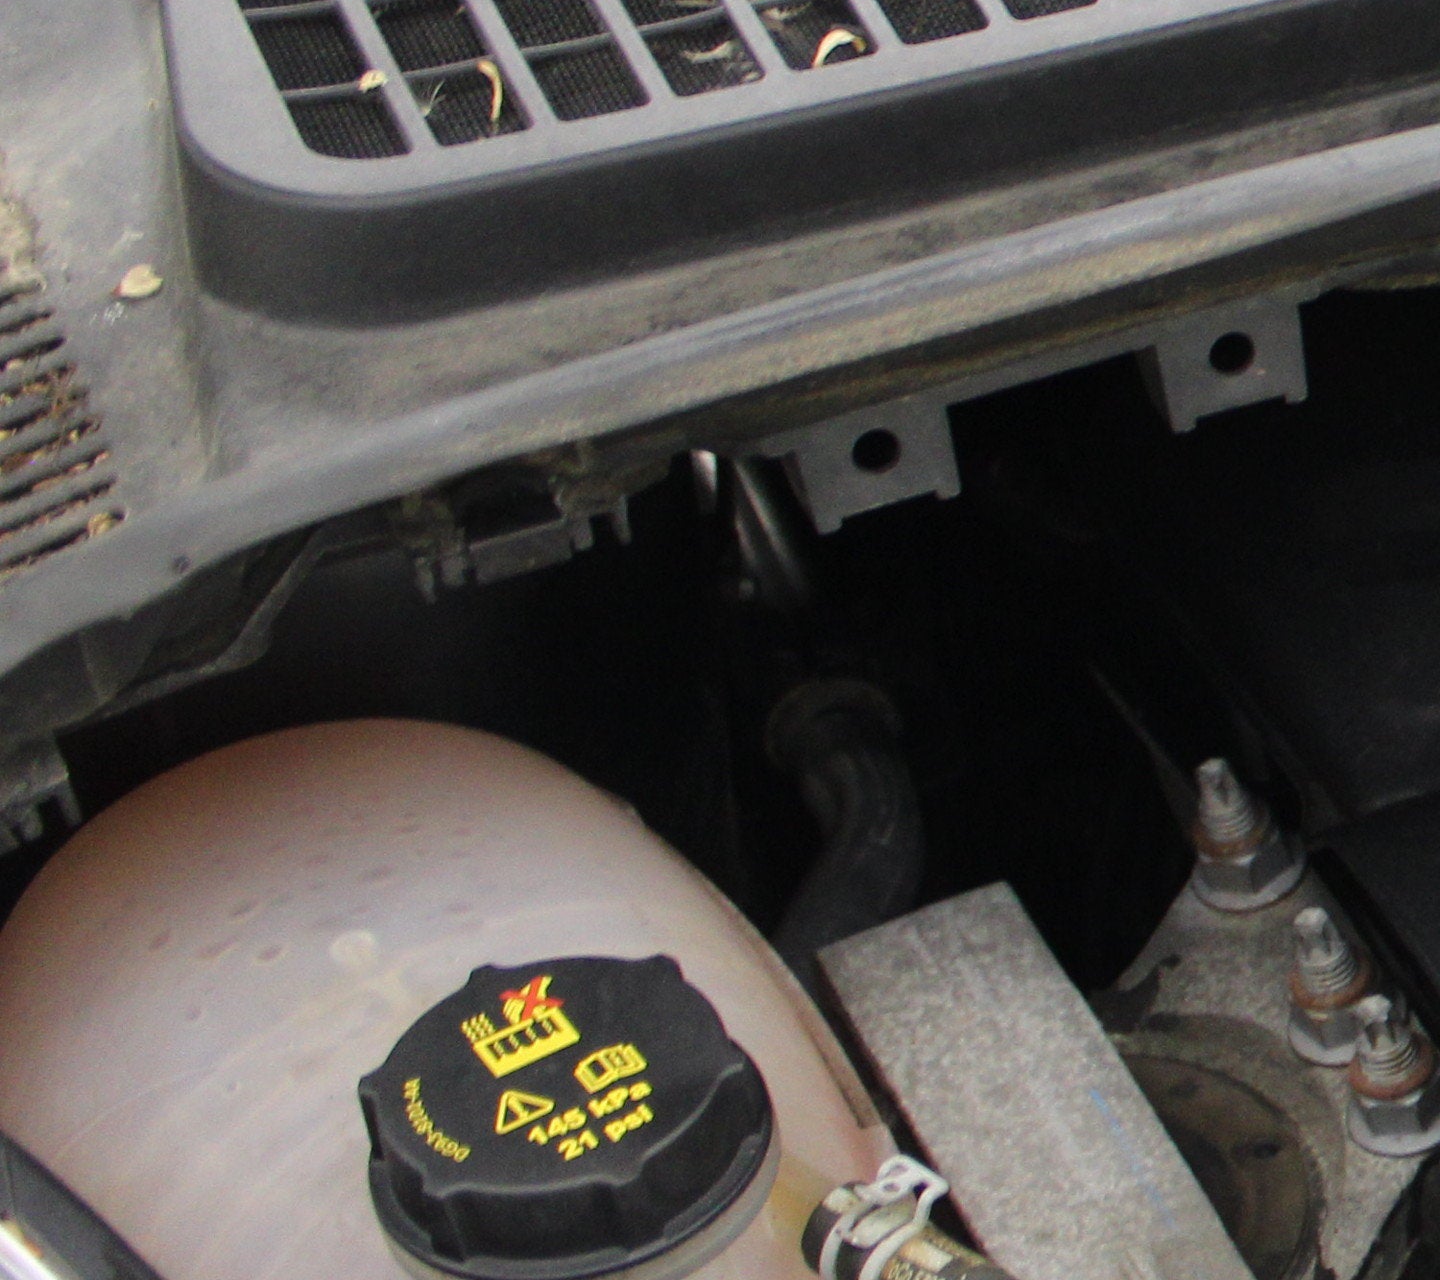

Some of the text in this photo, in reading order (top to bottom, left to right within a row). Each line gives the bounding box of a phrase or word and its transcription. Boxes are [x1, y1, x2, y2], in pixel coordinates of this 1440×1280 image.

[528, 1106, 587, 1146] 145
[558, 1103, 654, 1161] 21 psi
